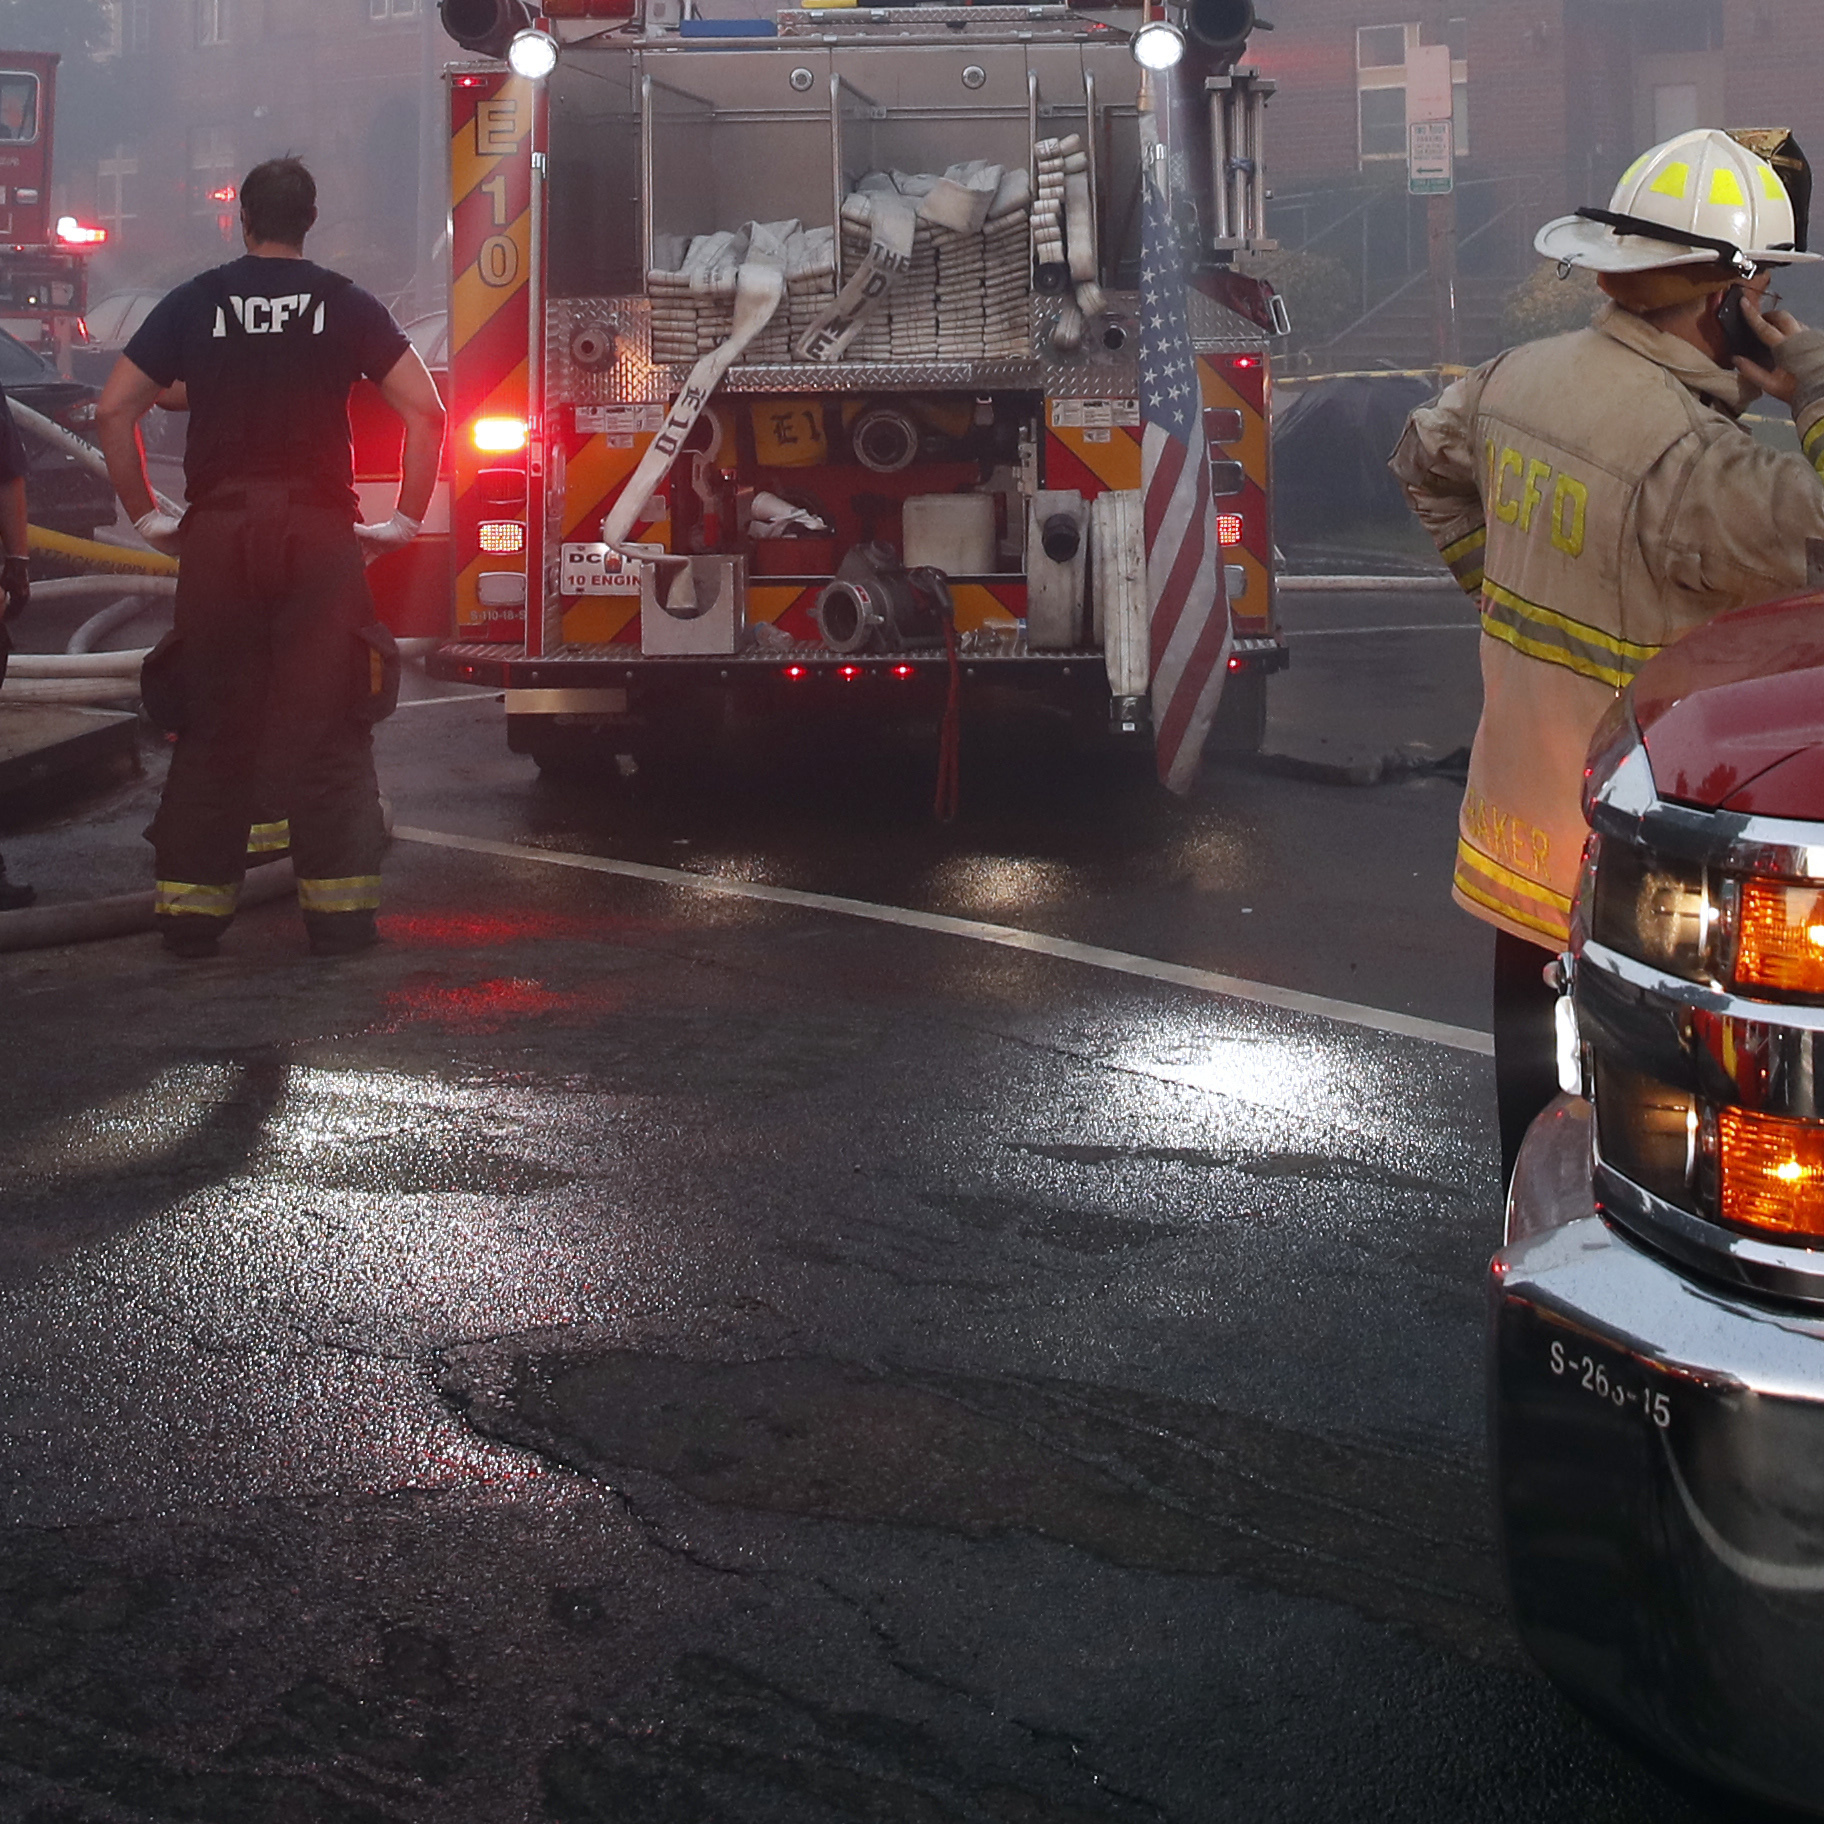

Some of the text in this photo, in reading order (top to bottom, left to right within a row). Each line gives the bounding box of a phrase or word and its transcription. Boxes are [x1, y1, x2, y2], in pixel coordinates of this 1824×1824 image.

[873, 241, 913, 273] THE
[567, 575, 642, 586] 10 ENGIN
